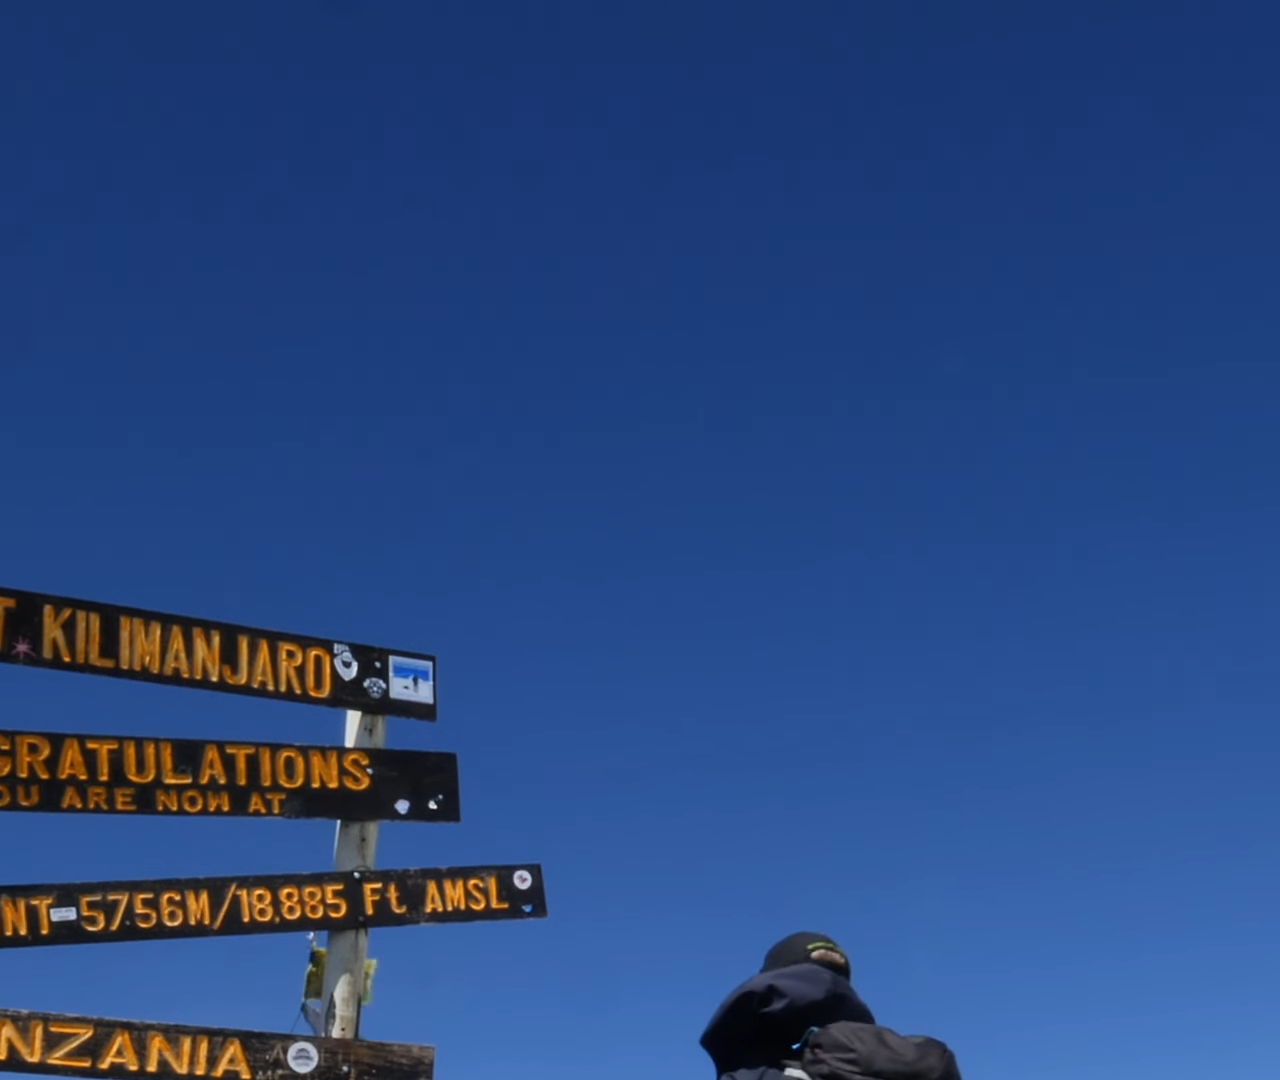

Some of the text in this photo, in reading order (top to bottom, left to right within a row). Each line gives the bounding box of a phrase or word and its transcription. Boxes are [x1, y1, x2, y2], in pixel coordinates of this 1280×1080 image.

[41, 603, 332, 699] KILIMANJARO
[61, 786, 137, 811] ARE
[156, 789, 230, 814] NOW
[248, 792, 287, 815] AT
[424, 875, 510, 914] AMSL
